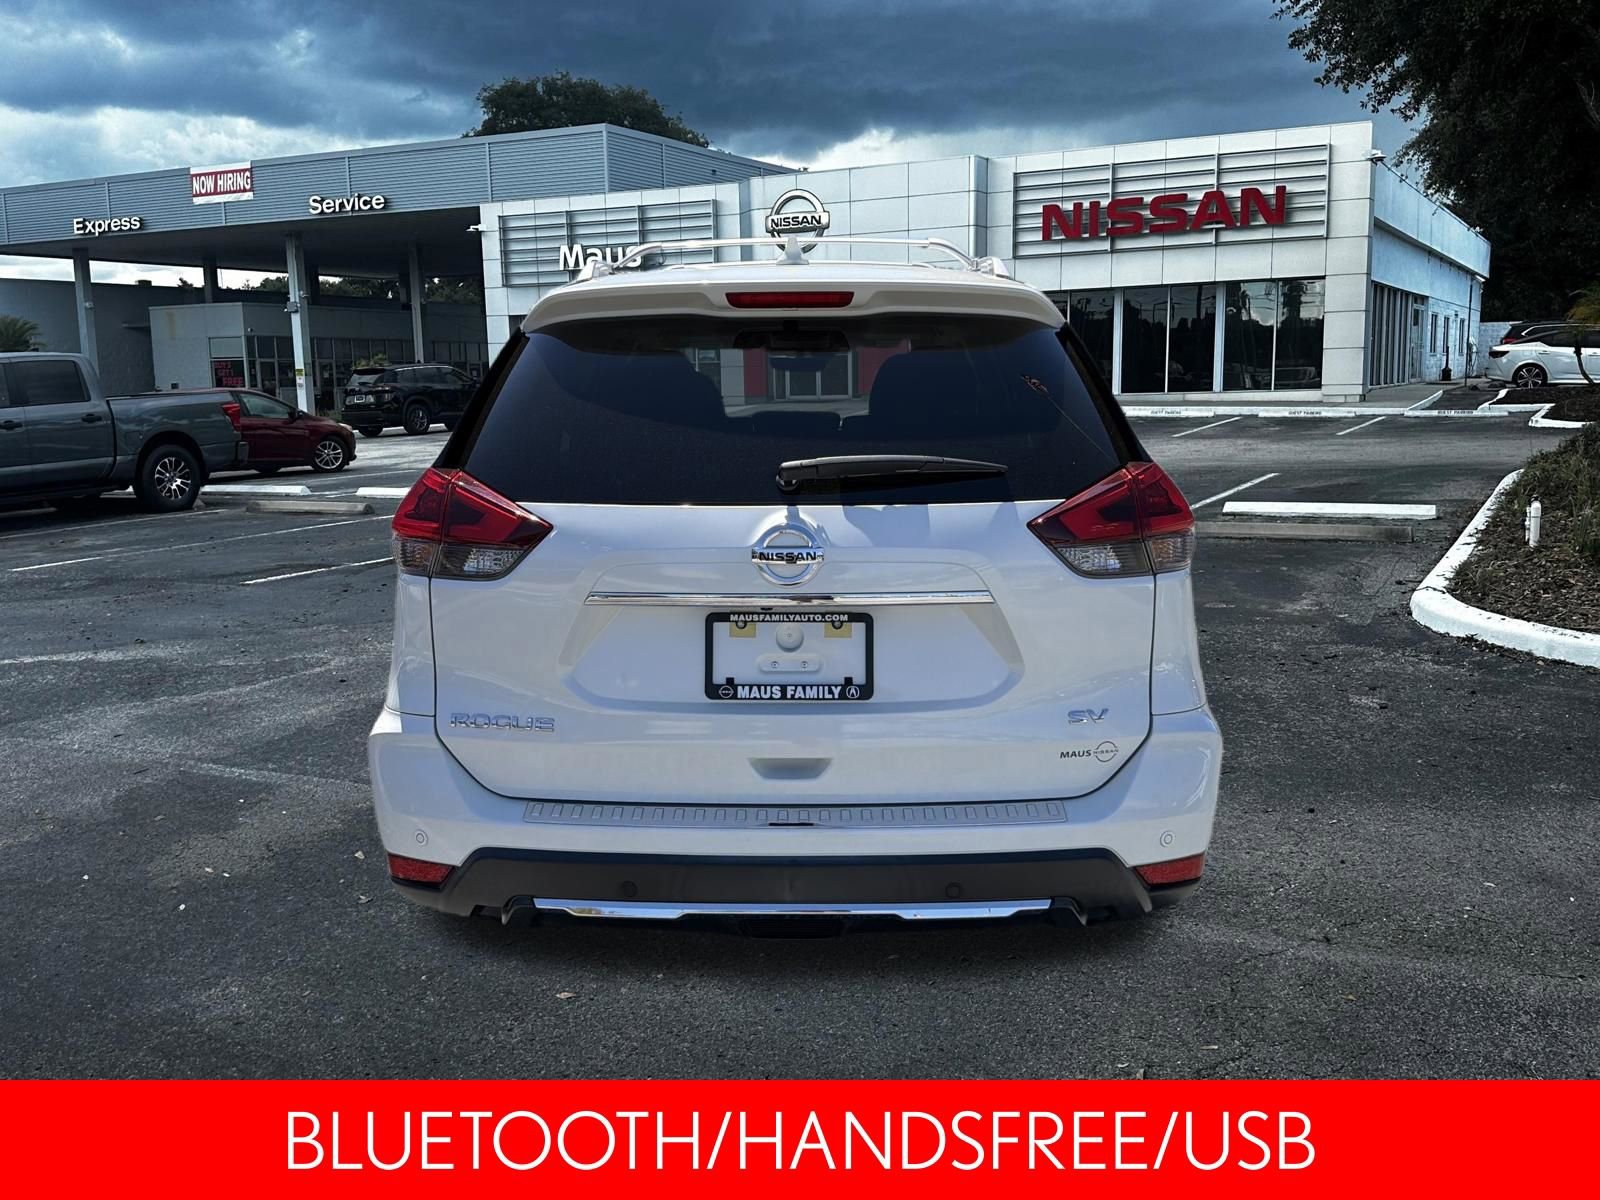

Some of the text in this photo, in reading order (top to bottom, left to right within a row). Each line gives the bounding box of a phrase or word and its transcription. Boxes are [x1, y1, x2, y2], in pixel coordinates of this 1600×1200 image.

[192, 170, 251, 195] NOW HIRING
[308, 192, 385, 214] Service
[1041, 184, 1288, 241] NISSAN
[73, 216, 141, 236] Express
[770, 214, 822, 229] NISSAN
[559, 243, 642, 270] Maus
[758, 551, 817, 562] NISSAN
[729, 613, 849, 622] MAUSFAMILYAUTO.COM
[736, 685, 842, 699] MAUS FAMILY
[450, 712, 556, 732] ROGUE
[1067, 707, 1110, 725] SV
[1059, 749, 1092, 759] MAUS
